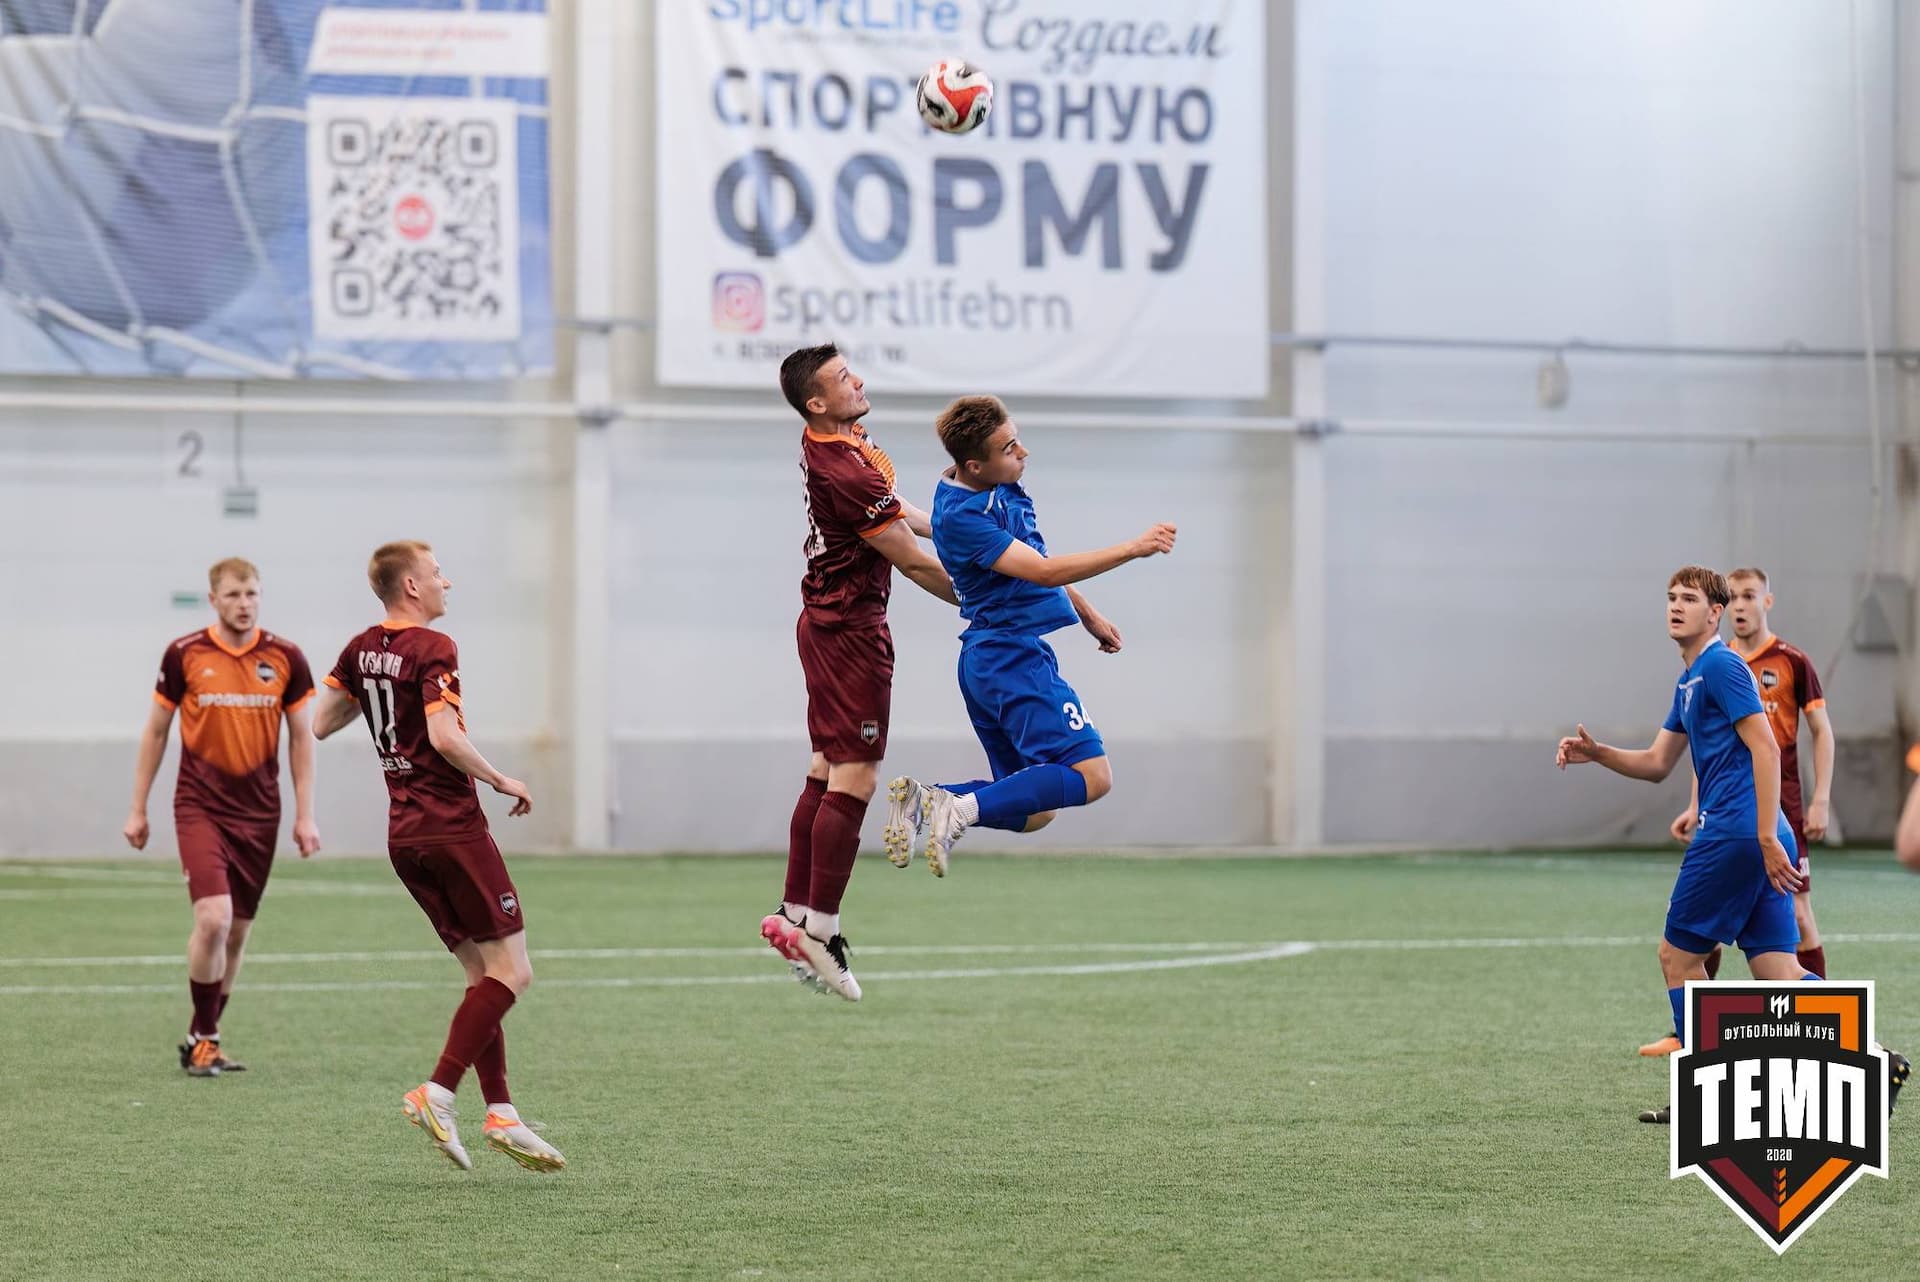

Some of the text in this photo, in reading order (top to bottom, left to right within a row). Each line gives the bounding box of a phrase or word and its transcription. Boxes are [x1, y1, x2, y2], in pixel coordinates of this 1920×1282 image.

[981, 0, 1231, 74] Создаем
[714, 67, 1214, 144] СПОРВНУЮ
[714, 147, 1210, 273] ФОРМУ
[773, 278, 1072, 332] sportlifebrn
[178, 429, 203, 478] 2
